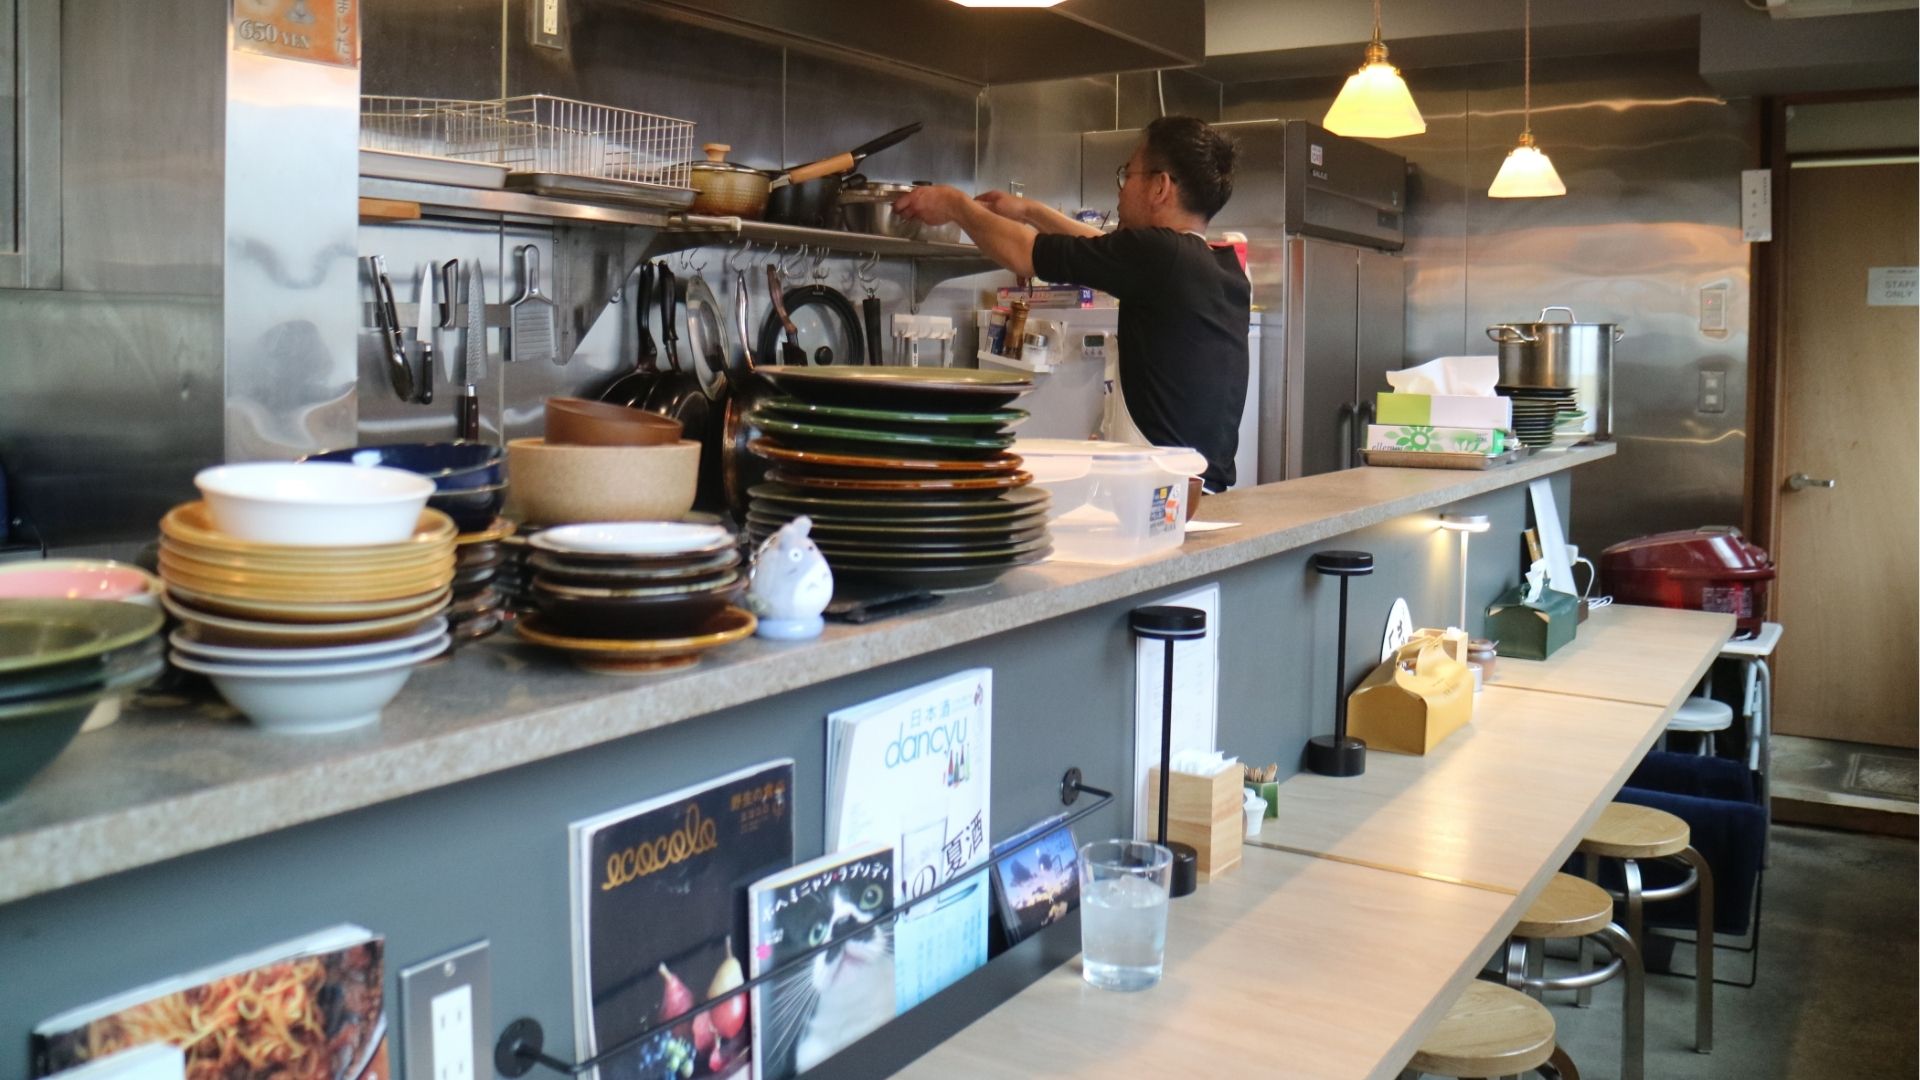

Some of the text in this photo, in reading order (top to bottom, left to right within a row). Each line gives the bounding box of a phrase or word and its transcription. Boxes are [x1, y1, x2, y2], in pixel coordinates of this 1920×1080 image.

[239, 19, 277, 44] 650
[910, 698, 950, 728] 日本酒
[884, 717, 968, 768] dancyu
[601, 803, 718, 890] ecocolo
